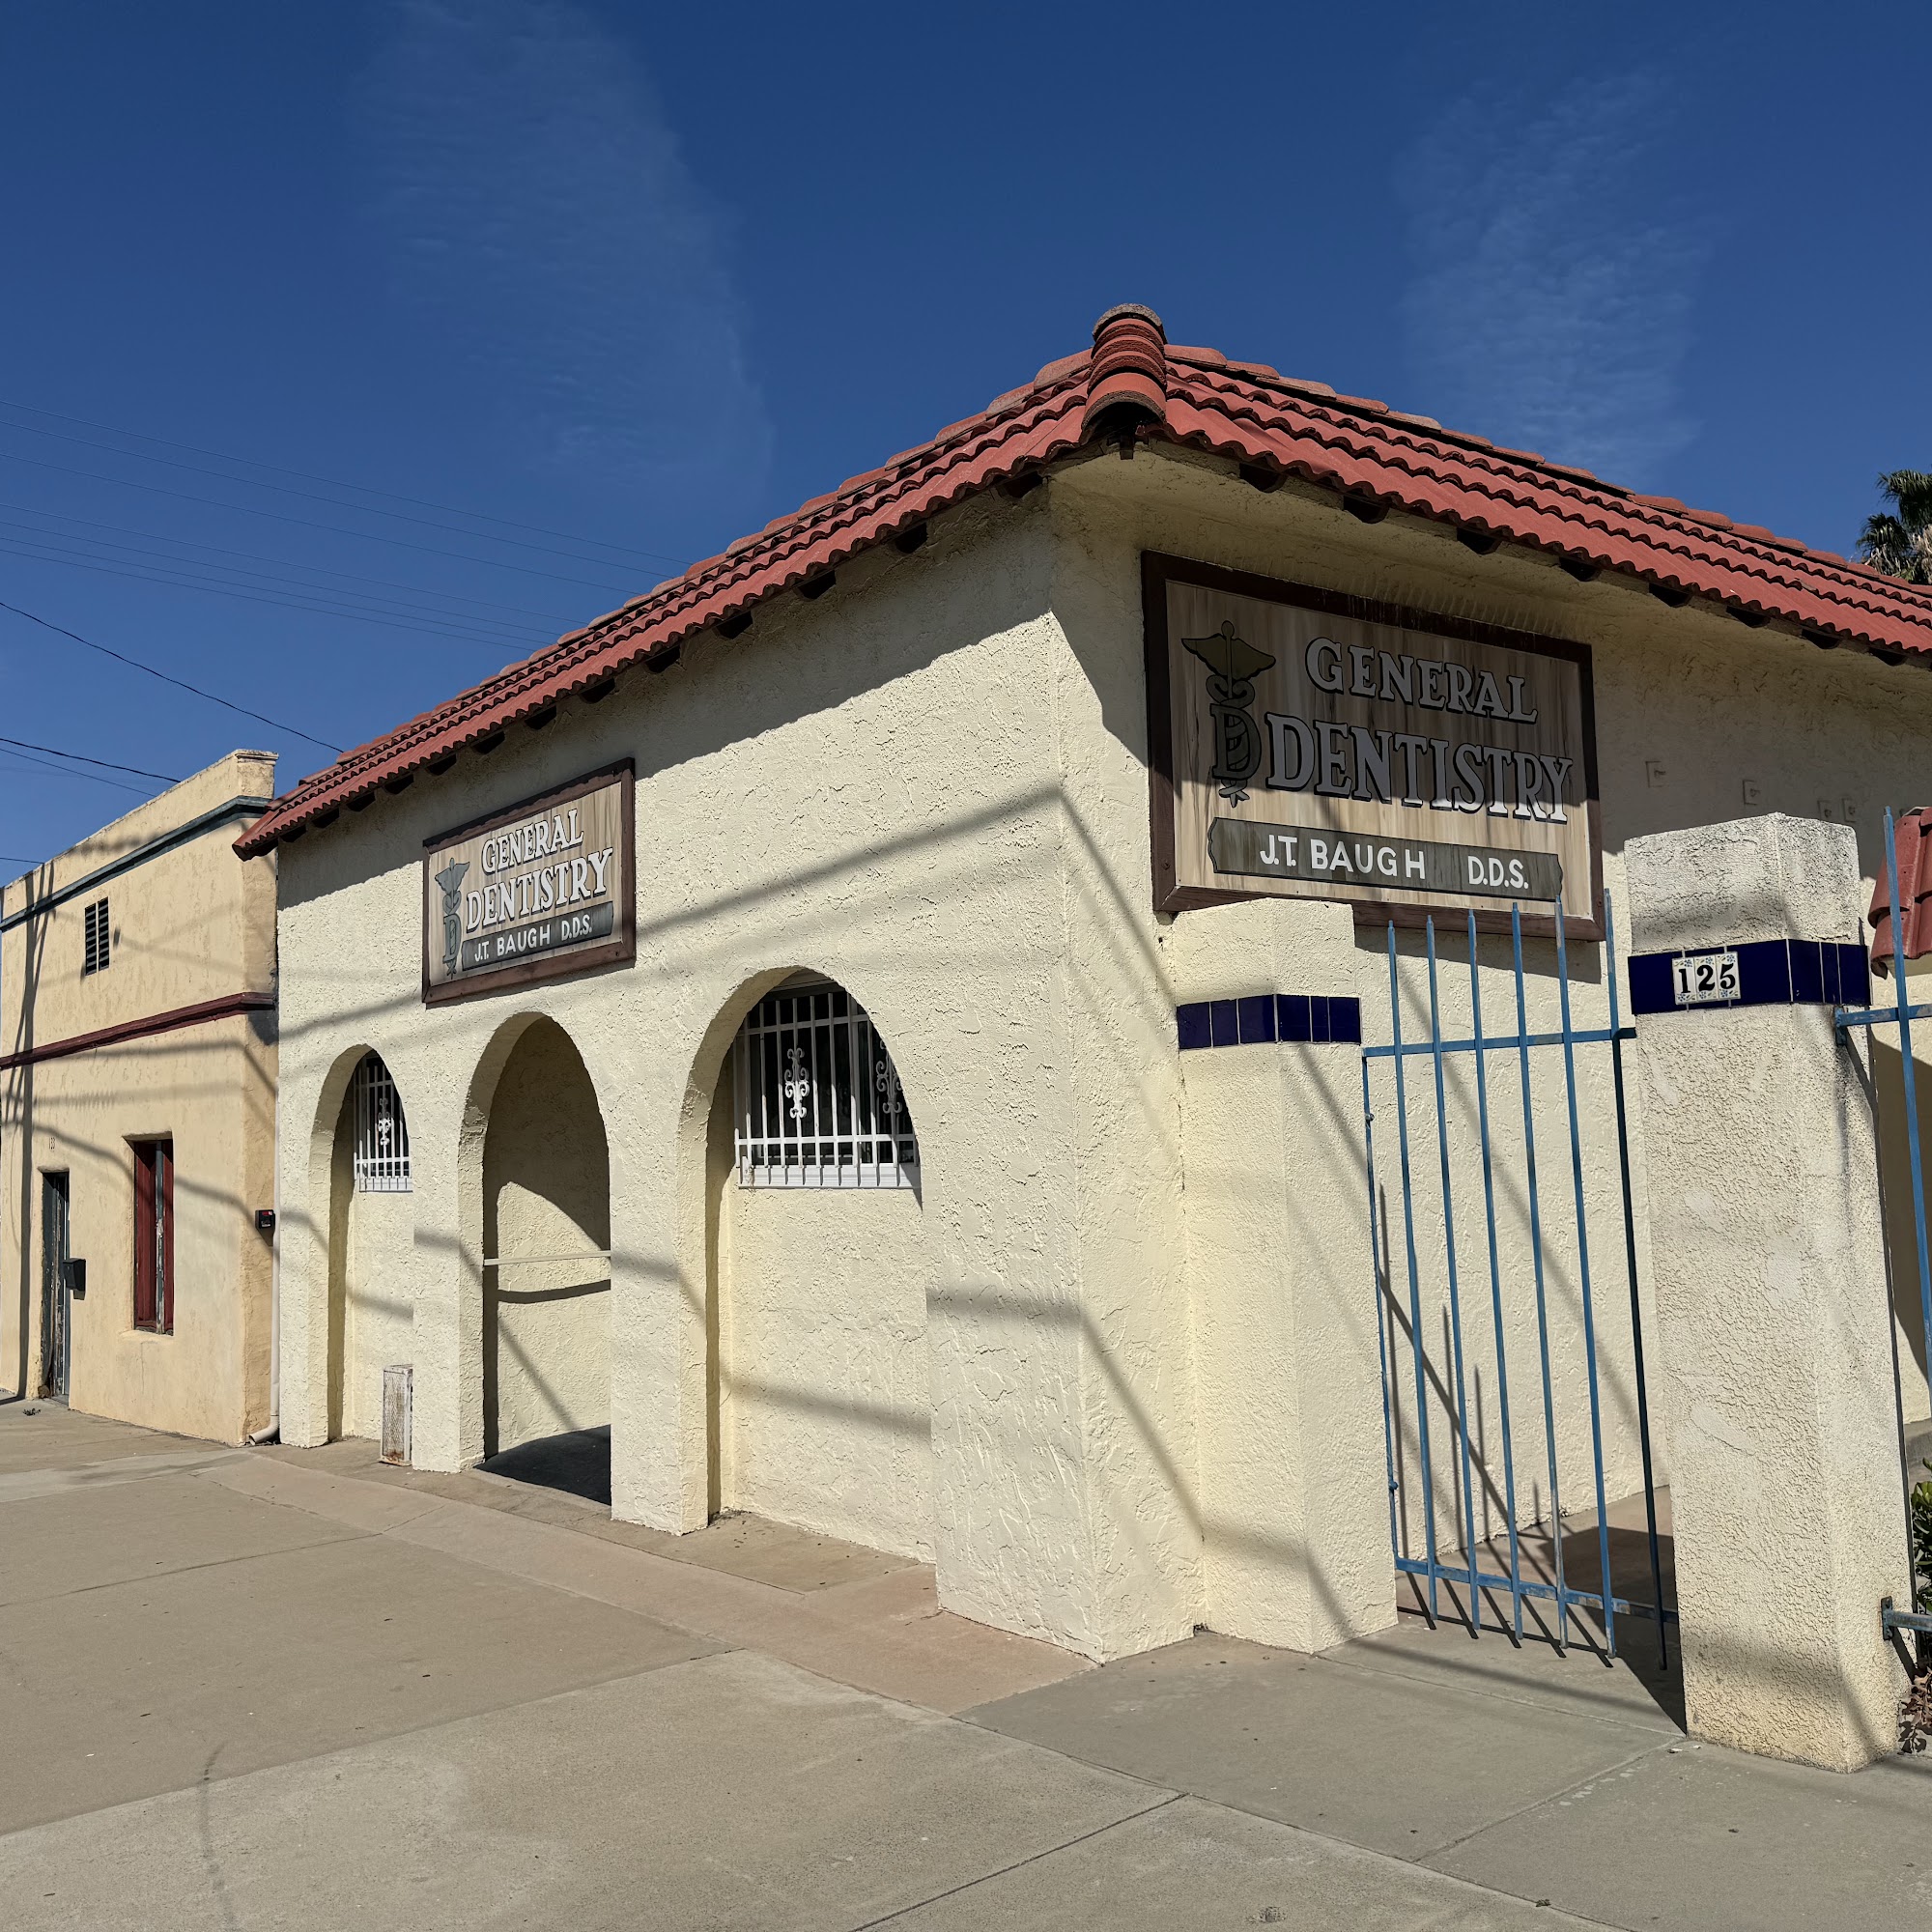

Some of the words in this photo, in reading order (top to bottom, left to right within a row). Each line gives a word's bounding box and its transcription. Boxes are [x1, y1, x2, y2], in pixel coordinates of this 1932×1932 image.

[1305, 637, 1539, 724] GENERAL
[1264, 712, 1573, 824] DENTISTRY
[481, 808, 584, 875] GENERAL
[1260, 834, 1297, 867] J.T.
[1310, 838, 1426, 880] BAUGH
[1467, 855, 1529, 889] D.D.S.
[466, 847, 613, 934] DENTISTRY
[474, 941, 490, 962] J.T.
[497, 923, 552, 956] BAUGH
[561, 914, 593, 941] D.D.S.
[1678, 962, 1737, 994] 125
